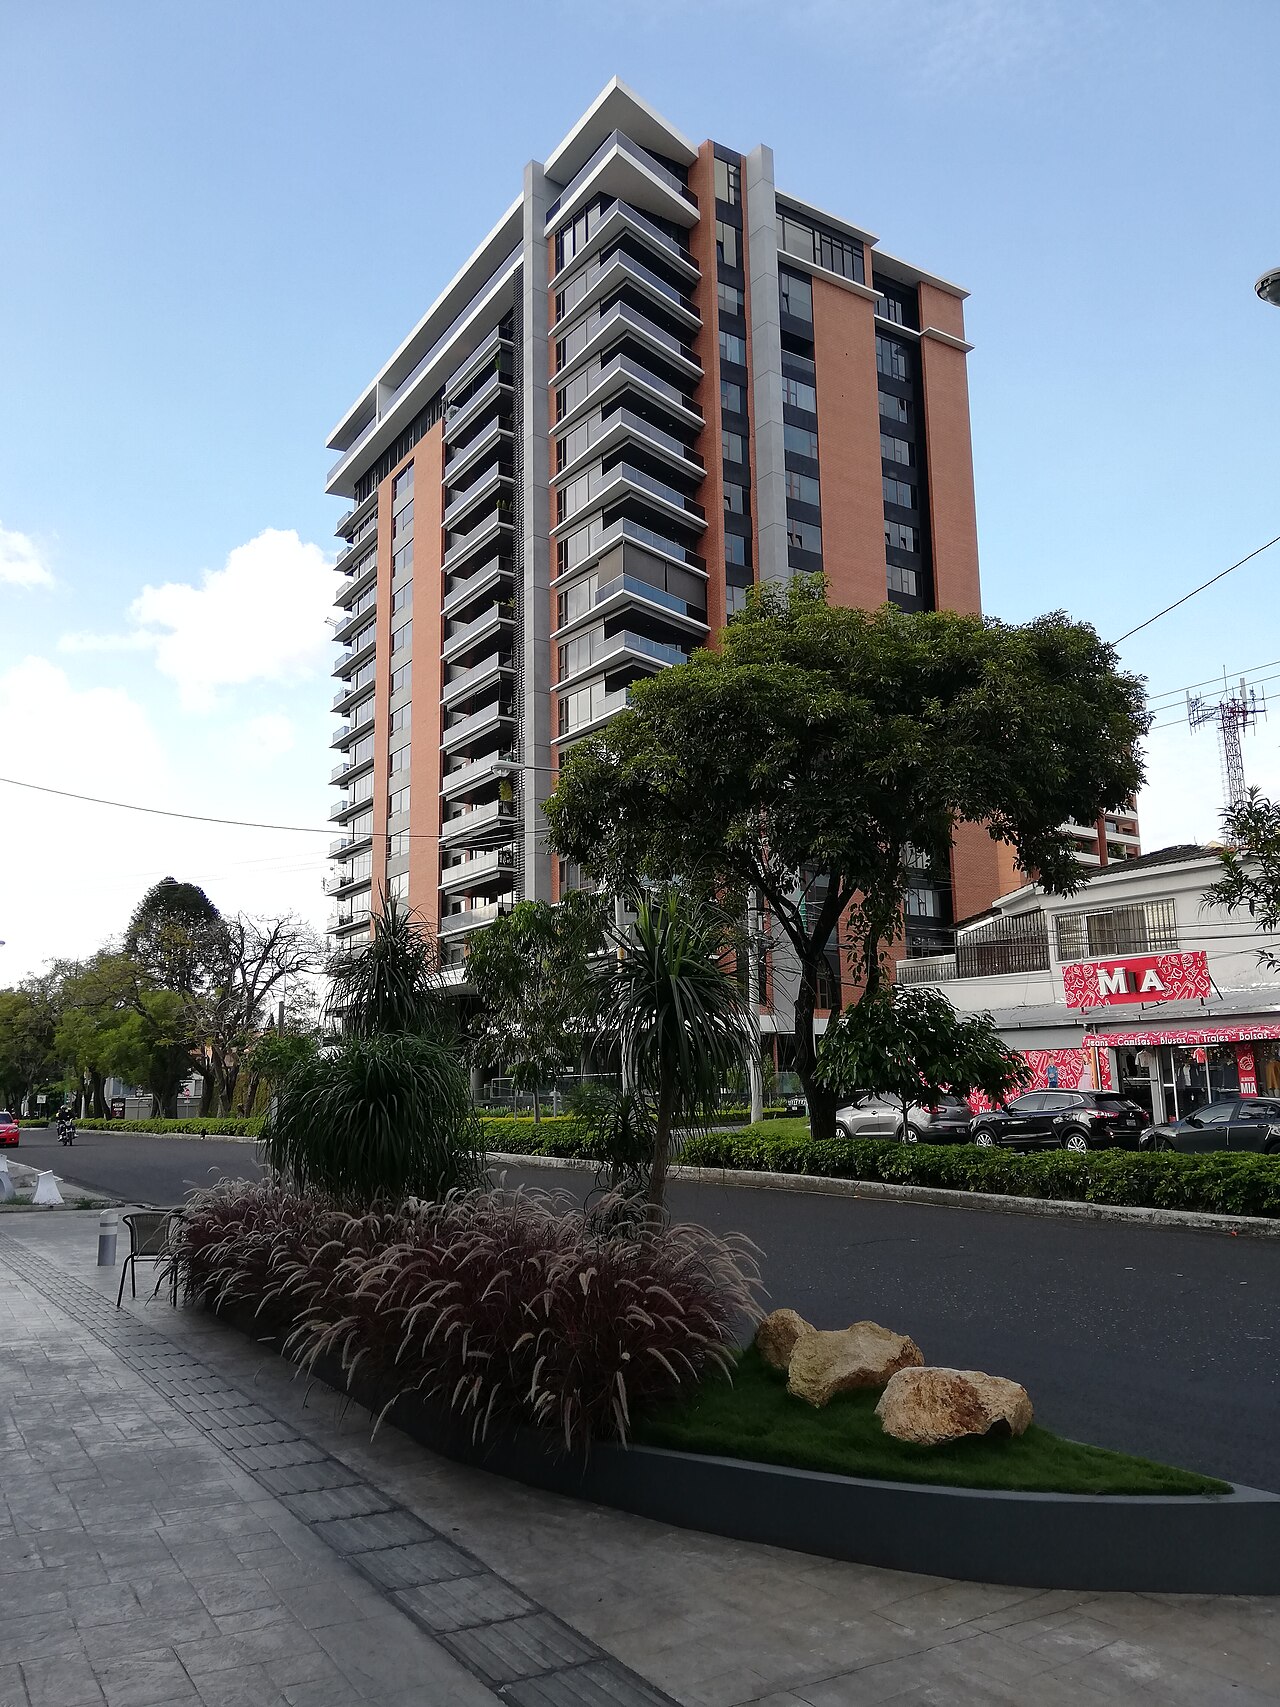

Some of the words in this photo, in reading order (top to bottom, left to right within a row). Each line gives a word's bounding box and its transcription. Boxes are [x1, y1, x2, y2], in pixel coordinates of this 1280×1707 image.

[1086, 1038, 1109, 1047] Jeans
[1117, 1037, 1150, 1046] Camisas
[1160, 1036, 1186, 1045] Blusas
[1203, 1034, 1229, 1043] Trajes
[1239, 1031, 1268, 1041] Bolsas
[1240, 1082, 1257, 1094] MIA
